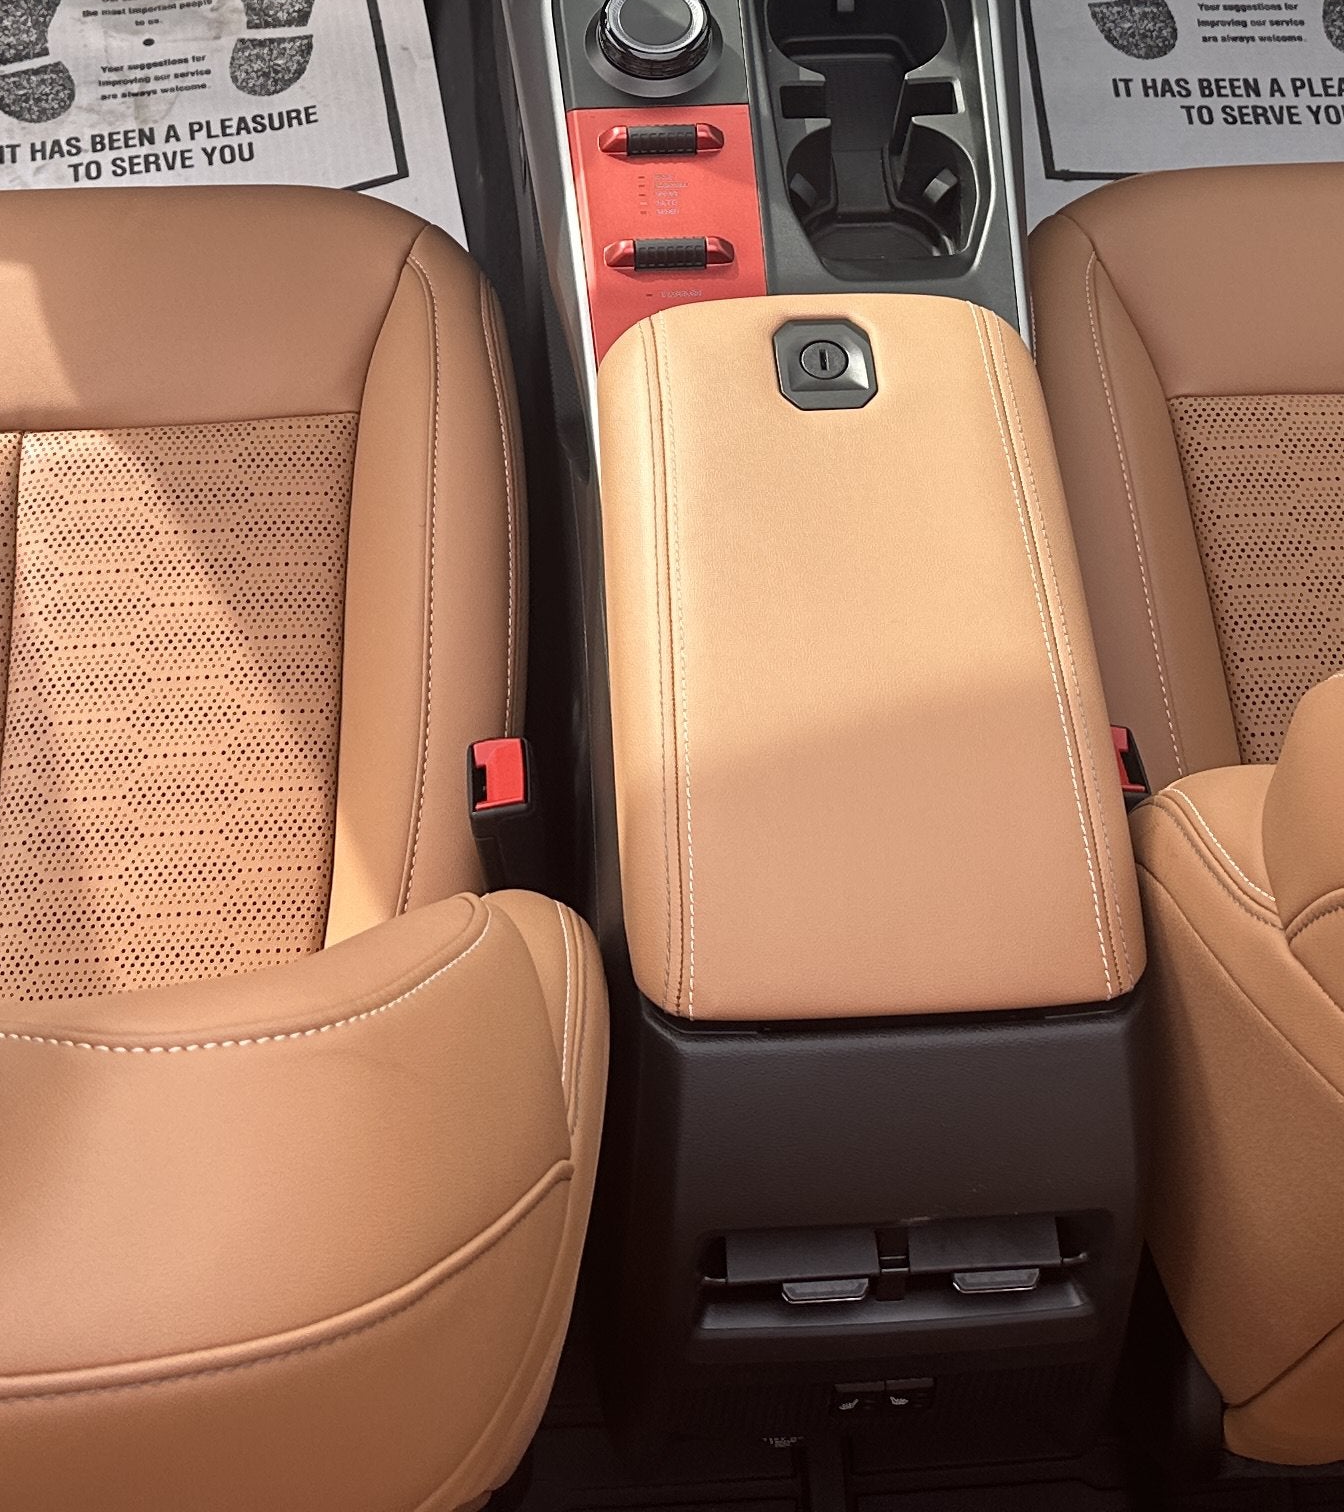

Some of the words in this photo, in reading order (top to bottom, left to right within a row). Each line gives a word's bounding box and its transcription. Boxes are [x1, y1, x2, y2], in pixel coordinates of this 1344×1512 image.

[82, 9, 98, 18] the
[1197, 3, 1221, 12] Your
[1222, 3, 1283, 13] suggestions
[1284, 2, 1299, 11] for
[1249, 19, 1267, 27] our
[1268, 18, 1305, 27] service
[1201, 35, 1218, 43] are
[1220, 34, 1256, 44] always
[100, 65, 124, 74] Your
[127, 57, 189, 71] suggestions
[191, 54, 207, 63] for
[153, 73, 171, 82] our
[173, 68, 212, 80] service
[100, 93, 118, 101] are
[120, 88, 158, 98] always
[1111, 77, 1134, 98] IT
[1140, 77, 1192, 98] HAS
[1197, 77, 1262, 98] BEEN
[1268, 77, 1286, 98] A
[1180, 104, 1214, 125] TO
[1221, 104, 1303, 125] SERVE
[29, 136, 83, 162] HAS
[90, 126, 156, 153] BEEN
[163, 124, 182, 144] A
[188, 105, 319, 141] PLEASURE
[68, 159, 102, 183] TO
[111, 148, 195, 178] SERVE
[200, 142, 255, 166] YOU
